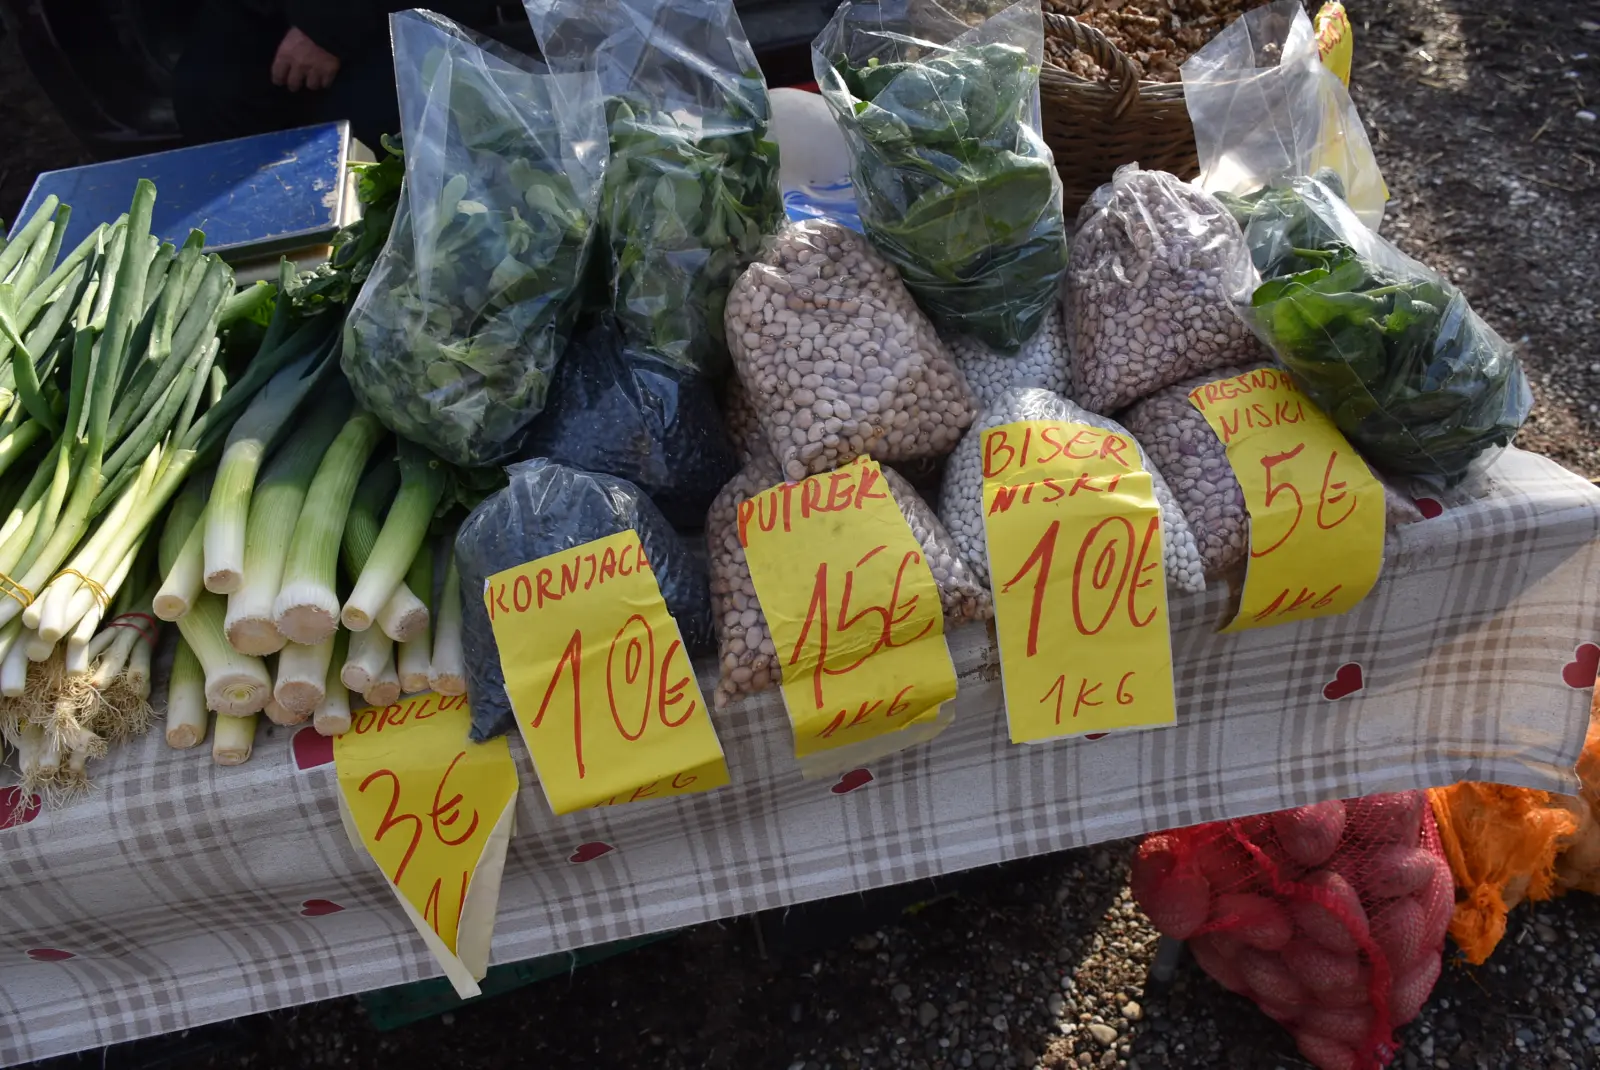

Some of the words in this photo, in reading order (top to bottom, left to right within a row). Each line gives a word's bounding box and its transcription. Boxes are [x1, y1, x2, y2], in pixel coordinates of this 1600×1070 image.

[1189, 369, 1299, 410] TRESNJA
[1219, 401, 1305, 443] NISKI
[983, 427, 1129, 478] BISER
[738, 466, 887, 548] PUTREK
[989, 473, 1121, 516] NISKI
[1251, 442, 1356, 558] 5€
[489, 543, 650, 620] KORNJACA
[1001, 516, 1159, 657] 10€
[789, 545, 934, 709] 15€
[531, 614, 695, 779] 10€
[359, 752, 479, 885] 3€
